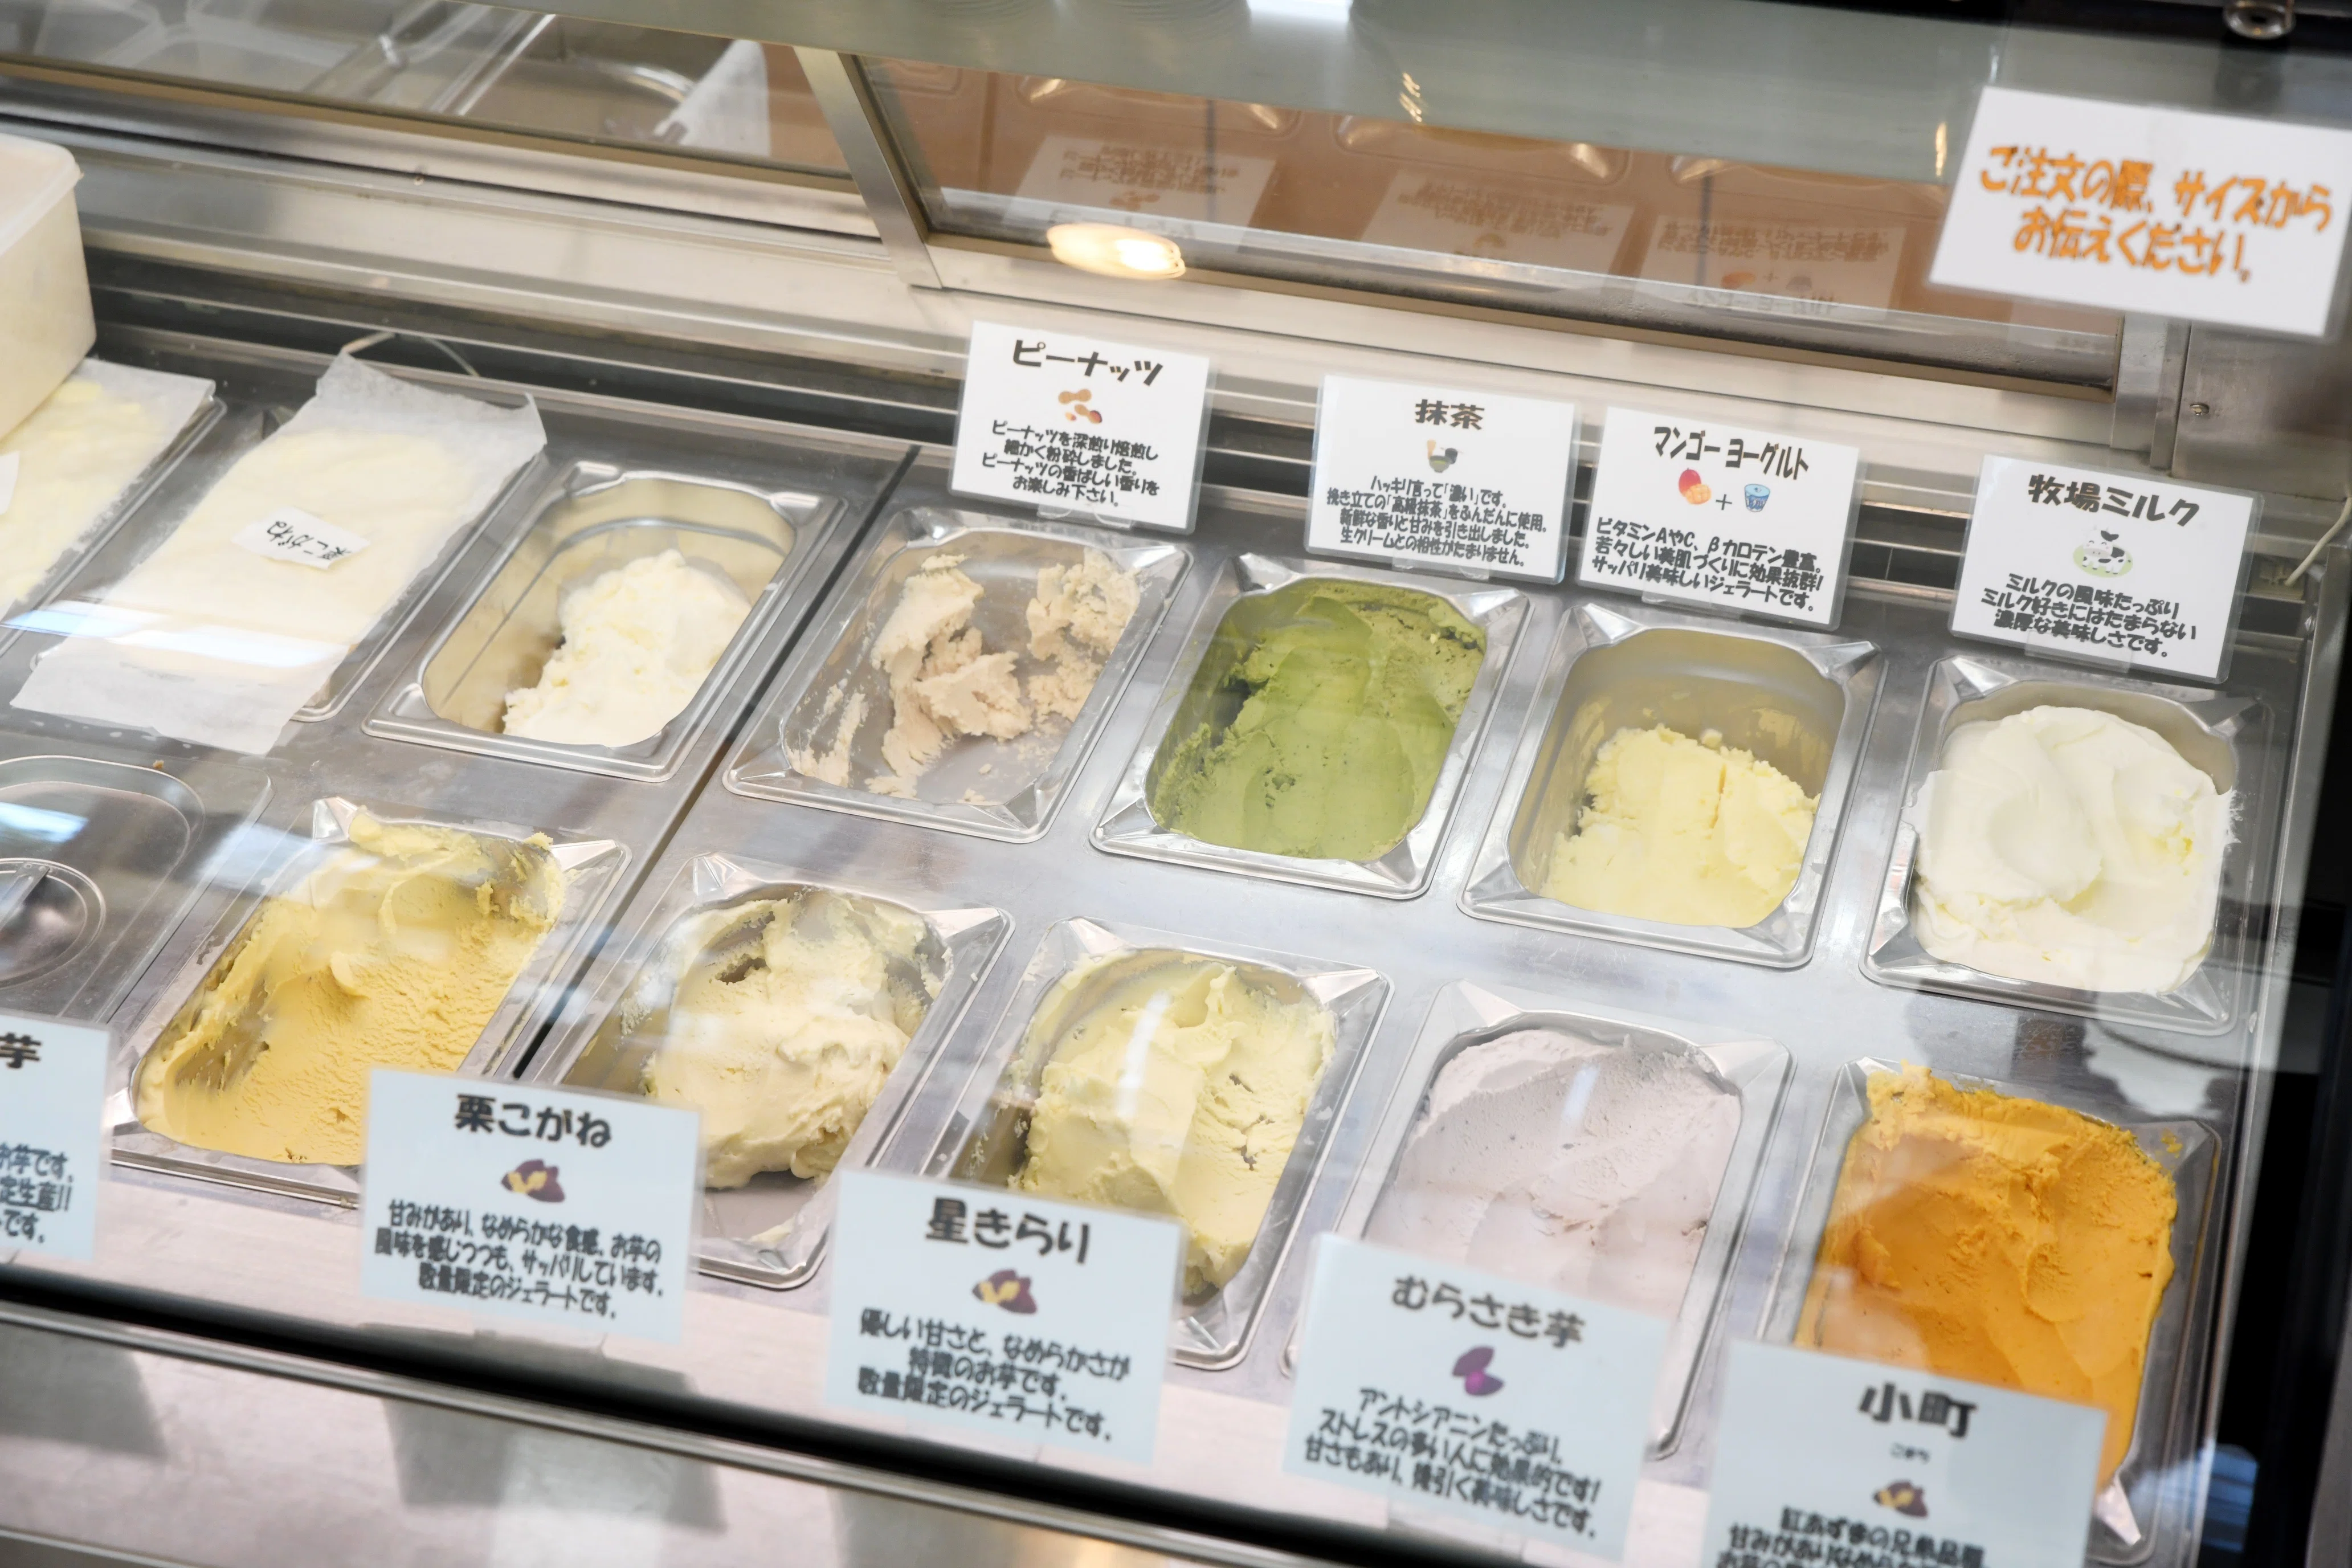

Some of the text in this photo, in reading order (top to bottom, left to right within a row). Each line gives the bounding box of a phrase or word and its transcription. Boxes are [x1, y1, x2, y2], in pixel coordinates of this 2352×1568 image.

[2013, 205, 2250, 283] お伝えください。
[1013, 340, 1163, 386] ピーナッツ
[1415, 399, 1485, 430] 抹茶
[982, 452, 1159, 496] ピーナッツの香ばしい香りを
[1004, 439, 1137, 476] 細かく粉砕しました。
[1654, 426, 1809, 480] マンゴー ヨーグルト
[1013, 476, 1118, 507] お楽しみ下さい。
[2028, 474, 2200, 526] 牧場ミルク
[1592, 555, 1814, 611] サッパリ美味しいジェラートです。
[2006, 573, 2179, 619] ミルクの風味たっぷり
[1981, 588, 2196, 640] ミルク好きにはたまらない
[454, 1093, 612, 1148] 栗こがね
[925, 1196, 1091, 1264] 星きらり
[1391, 1274, 1586, 1348] むらさき芋
[1857, 1381, 1978, 1440] 小町
